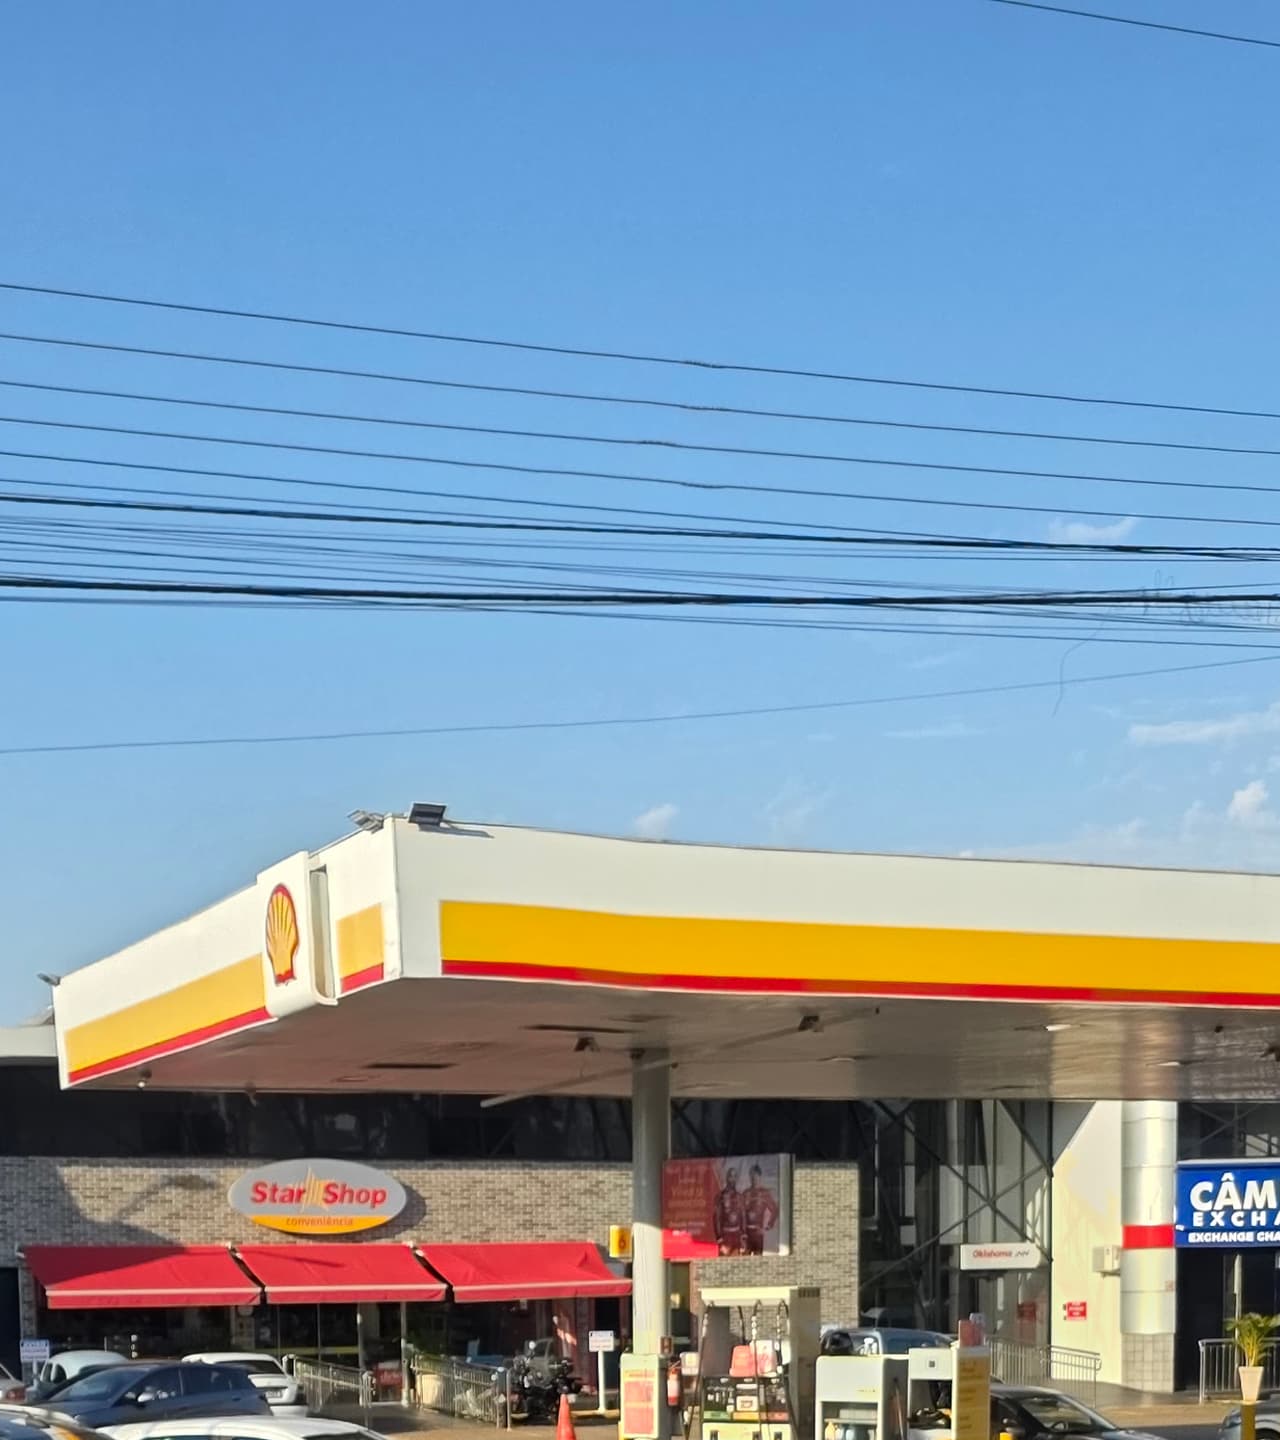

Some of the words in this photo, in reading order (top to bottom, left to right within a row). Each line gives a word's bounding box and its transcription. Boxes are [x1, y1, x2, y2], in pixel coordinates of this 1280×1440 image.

[250, 1181, 306, 1204] Star
[322, 1182, 388, 1209] Shop
[1188, 1231, 1254, 1243] EXCHANGE
